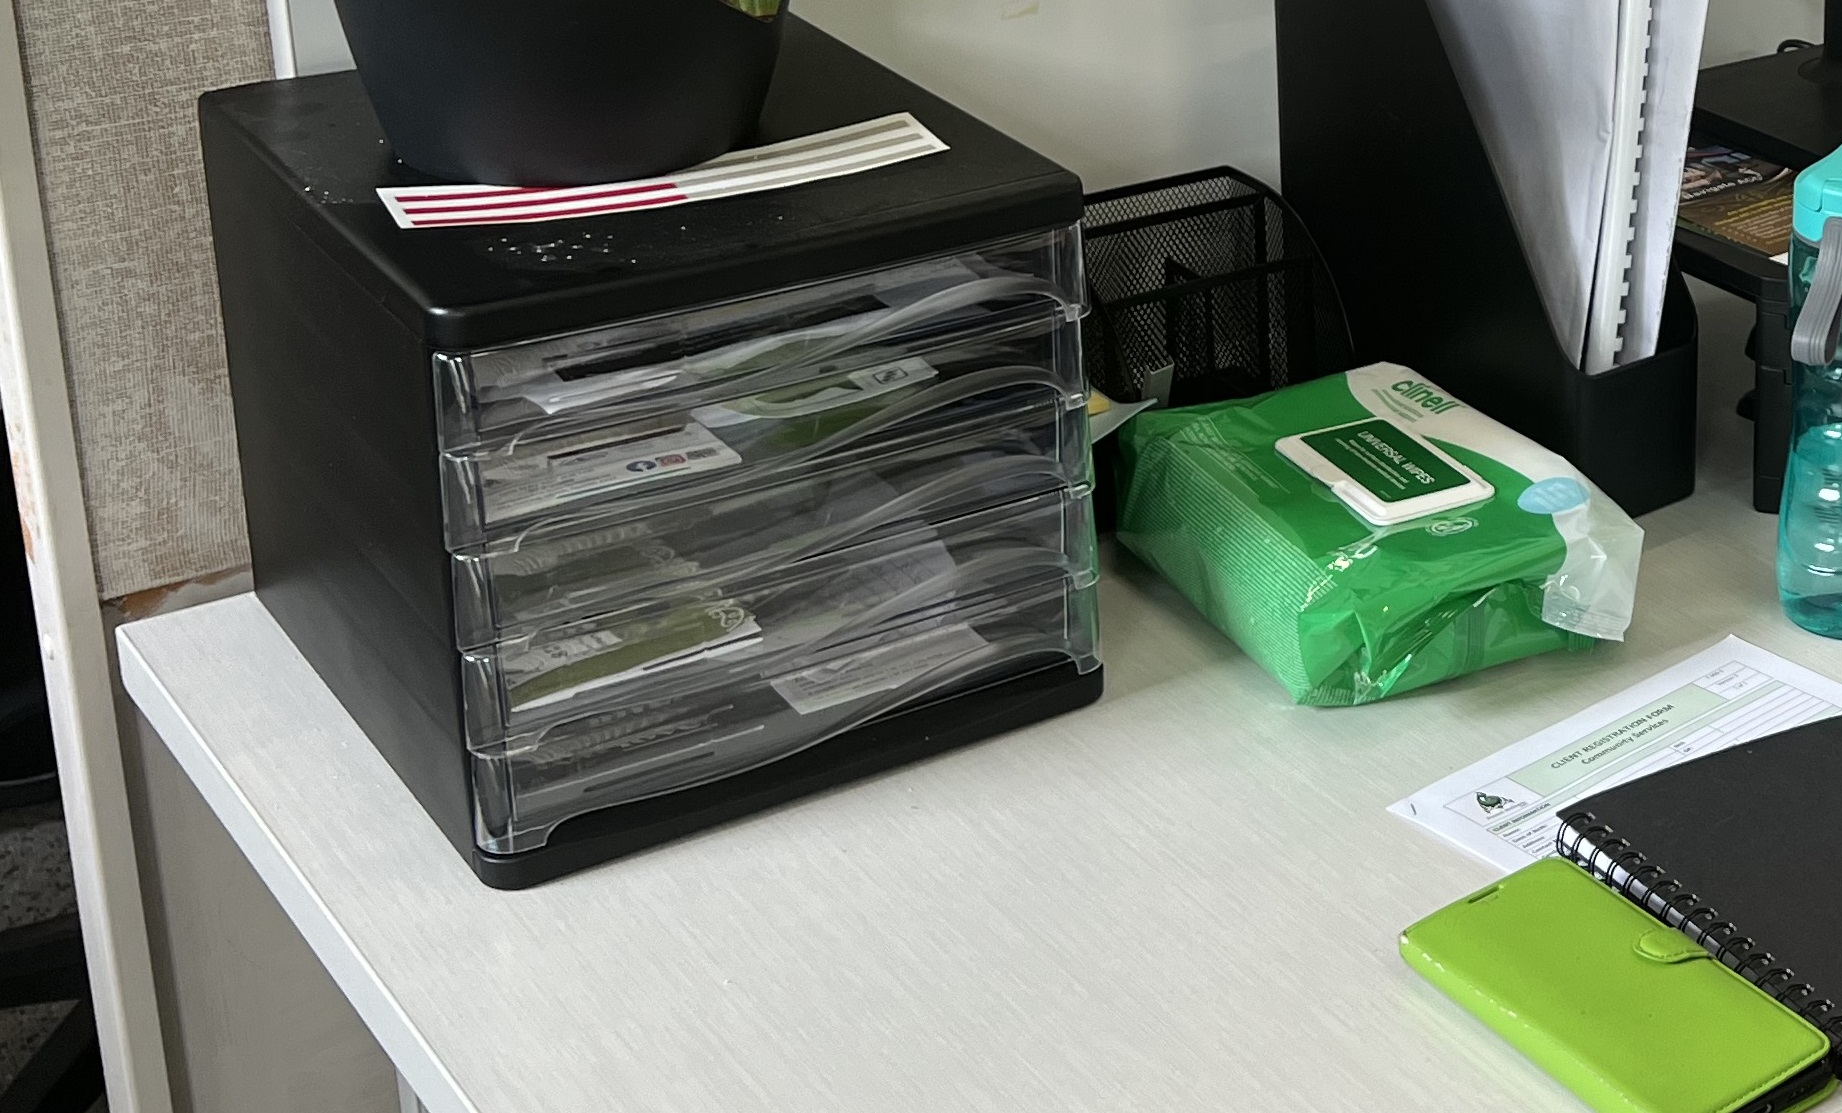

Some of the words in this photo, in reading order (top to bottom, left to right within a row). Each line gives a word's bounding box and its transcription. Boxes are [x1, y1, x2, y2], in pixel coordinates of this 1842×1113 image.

[1391, 380, 1460, 414] clinell
[1357, 431, 1407, 464] UNIVERSAL
[1401, 462, 1435, 484] WIPES
[1551, 749, 1583, 769] CLIENT
[1583, 717, 1646, 753] REGISTRATION
[1647, 703, 1675, 721] FORM
[1581, 736, 1635, 765] Community
[1635, 719, 1669, 740] Services
